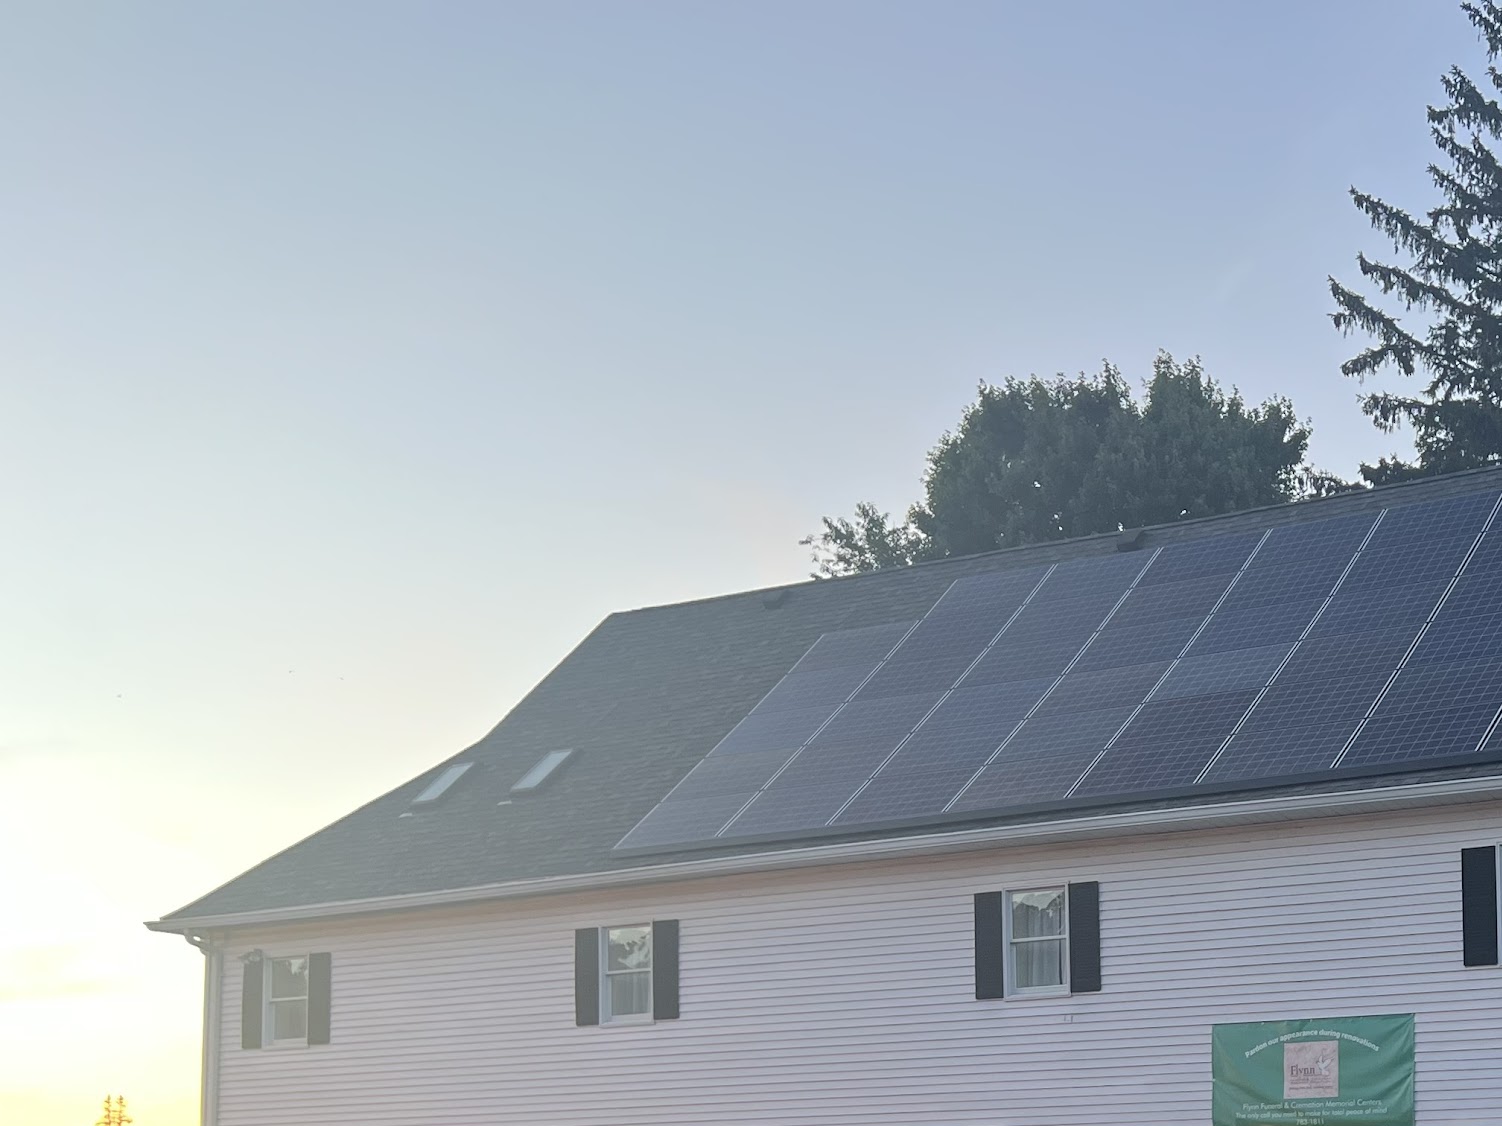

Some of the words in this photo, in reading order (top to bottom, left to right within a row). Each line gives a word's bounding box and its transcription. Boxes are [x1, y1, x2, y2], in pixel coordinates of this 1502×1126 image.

[1245, 1042, 1268, 1058] Pardon
[1268, 1037, 1279, 1046] our
[1279, 1029, 1318, 1042] appearance
[1319, 1029, 1341, 1039] during
[1341, 1033, 1380, 1052] renovations
[1290, 1064, 1315, 1076] Flynn
[1243, 1103, 1259, 1111] Flynn
[1260, 1102, 1283, 1110] Funeral
[1290, 1101, 1324, 1109] Cremation
[1247, 1111, 1259, 1120] only
[1272, 1112, 1282, 1120] you
